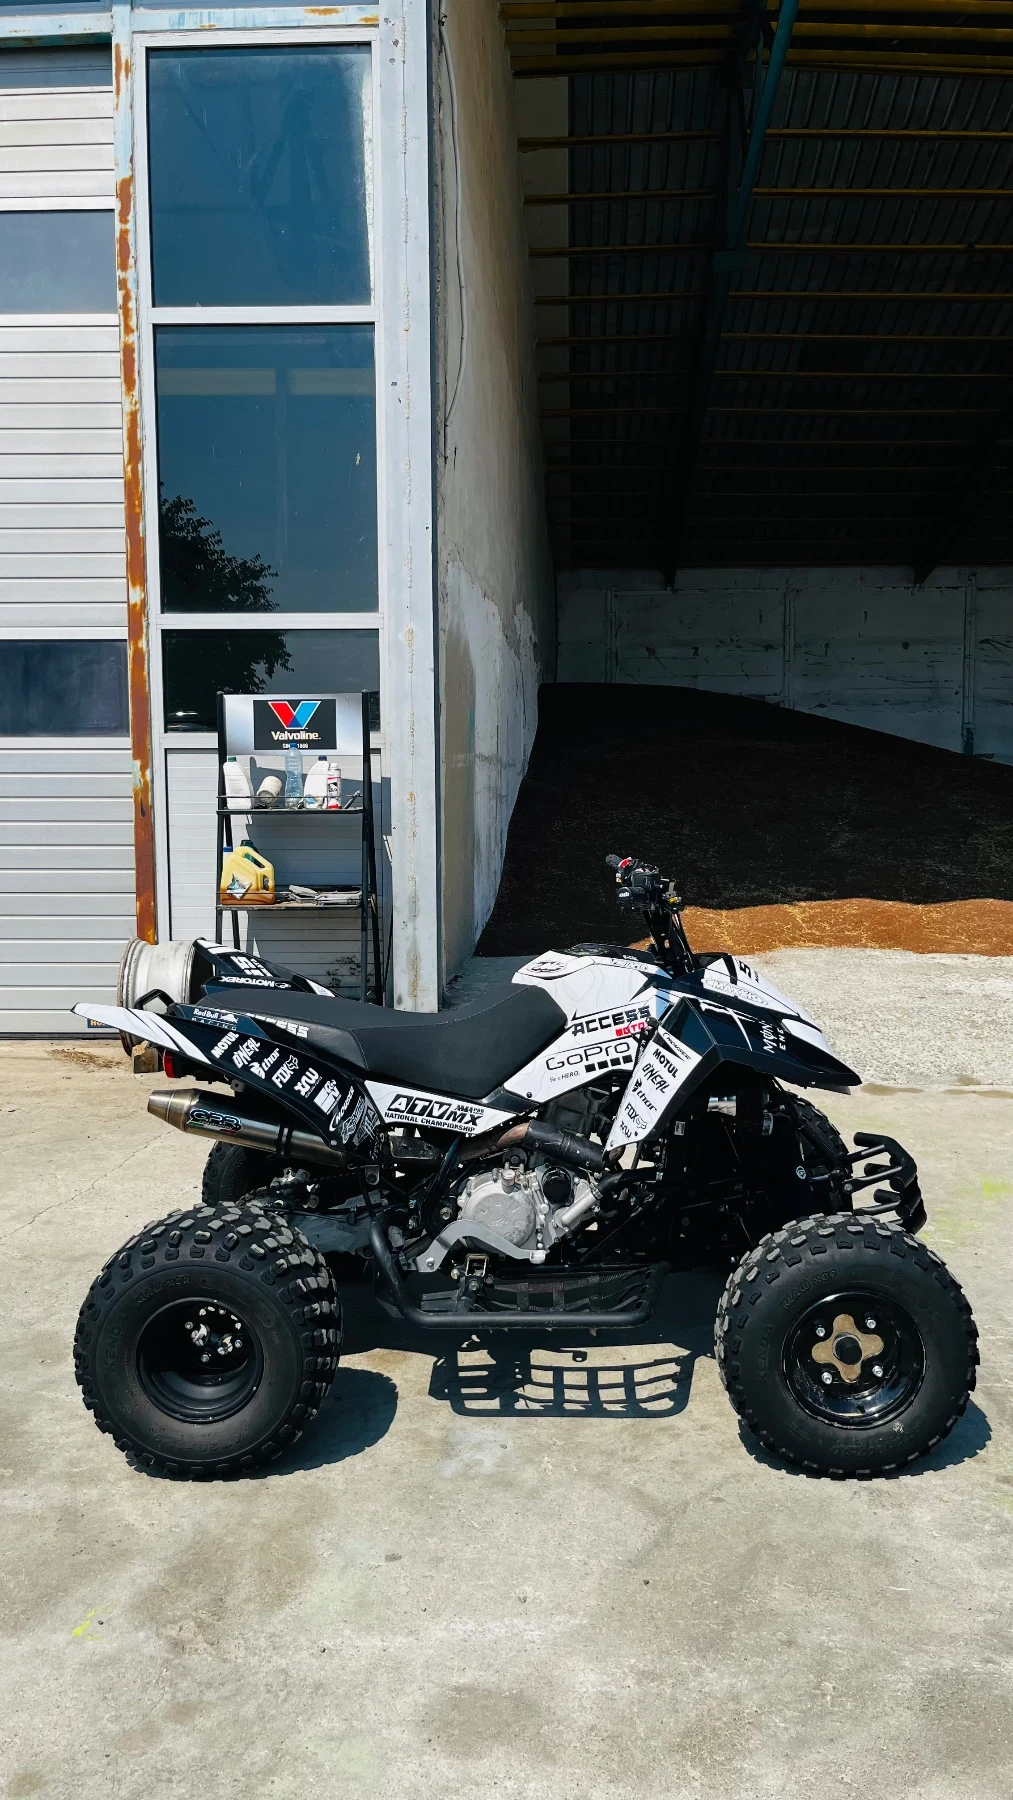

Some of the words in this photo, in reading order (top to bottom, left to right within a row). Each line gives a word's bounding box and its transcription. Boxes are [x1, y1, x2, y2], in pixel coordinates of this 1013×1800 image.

[219, 976, 275, 987] MOTOREX
[571, 1005, 651, 1037] ACCESS
[211, 1031, 240, 1059] MOTUL
[545, 1042, 631, 1071] GoPro
[652, 1048, 679, 1079] MOTUL
[384, 1111, 419, 1123] NATIONAL
[420, 1118, 476, 1133] CHAMPIONSHIP
